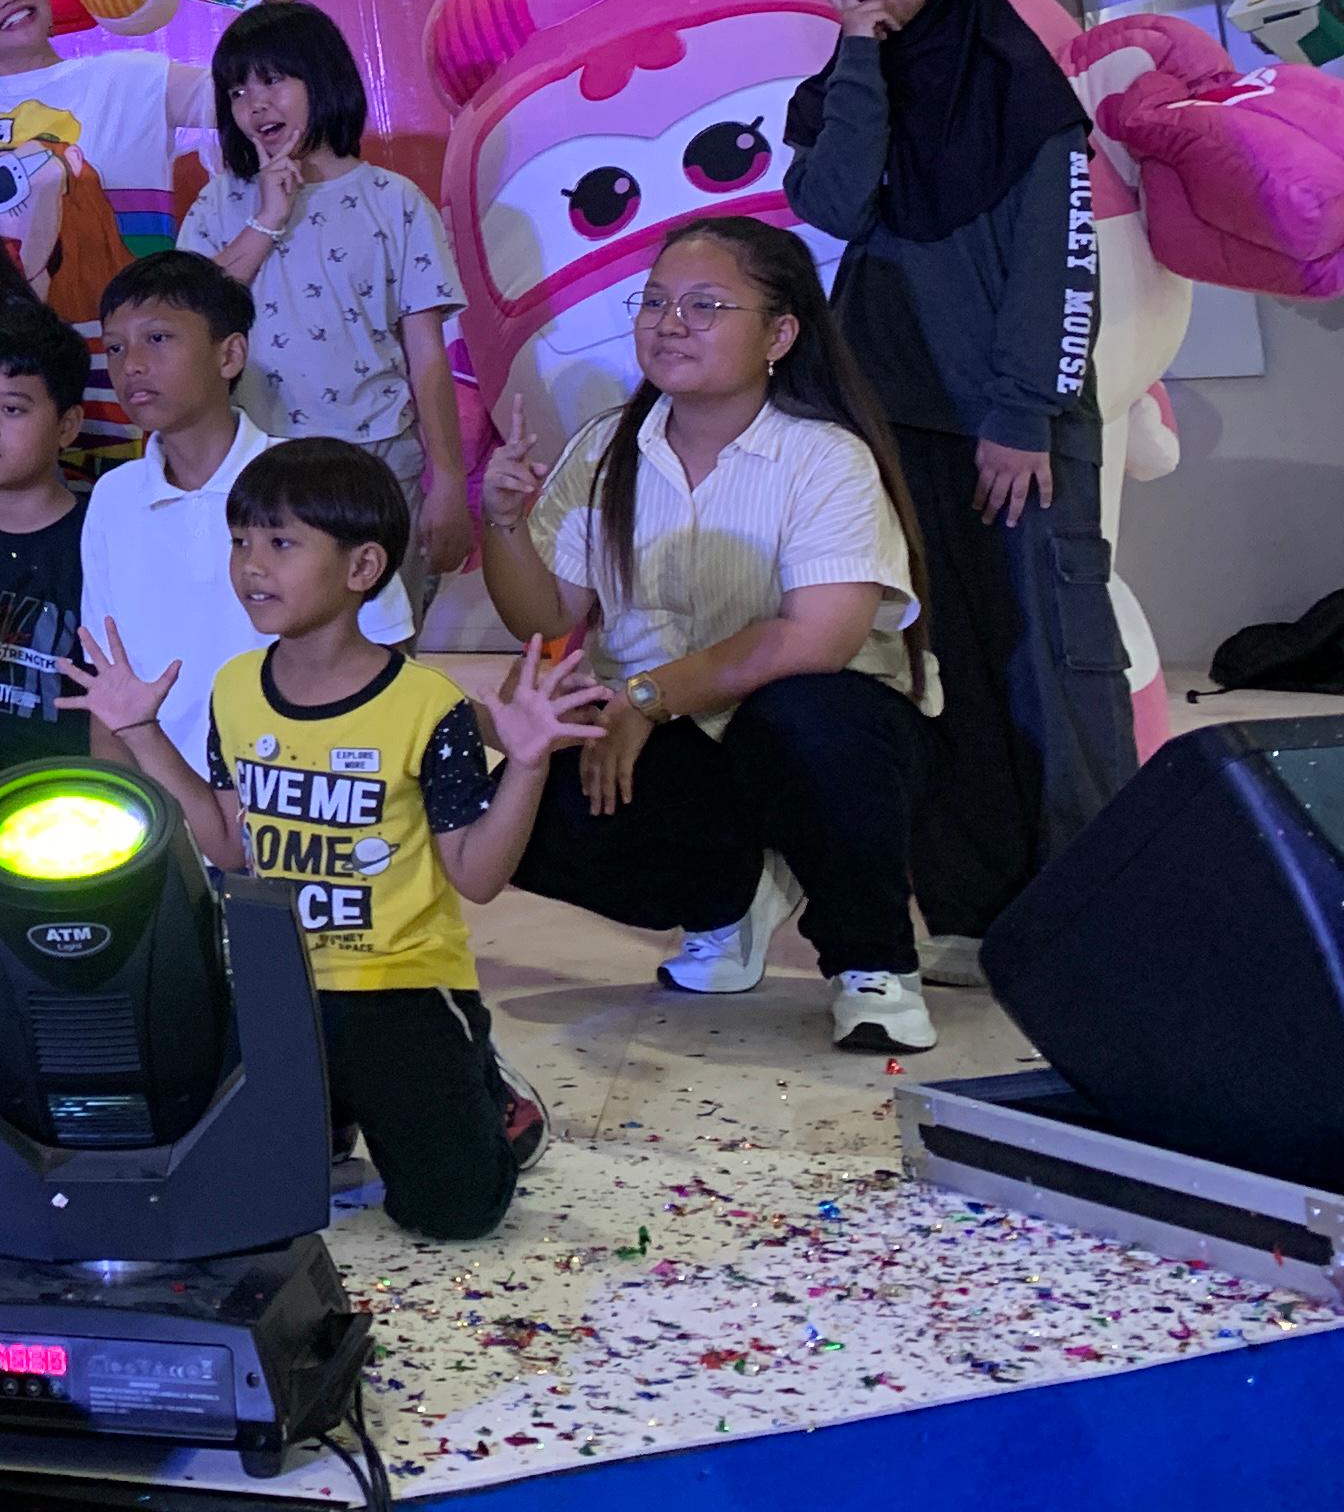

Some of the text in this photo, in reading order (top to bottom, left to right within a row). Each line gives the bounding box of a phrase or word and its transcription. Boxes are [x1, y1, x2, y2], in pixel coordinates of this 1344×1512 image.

[1066, 151, 1097, 274] MICKEY
[1057, 288, 1094, 397] MOUSE
[336, 751, 374, 760] EXPLORE
[344, 761, 367, 770] MORE
[235, 759, 381, 824] GIVE ME
[246, 822, 354, 878] OME
[46, 927, 92, 942] ATM
